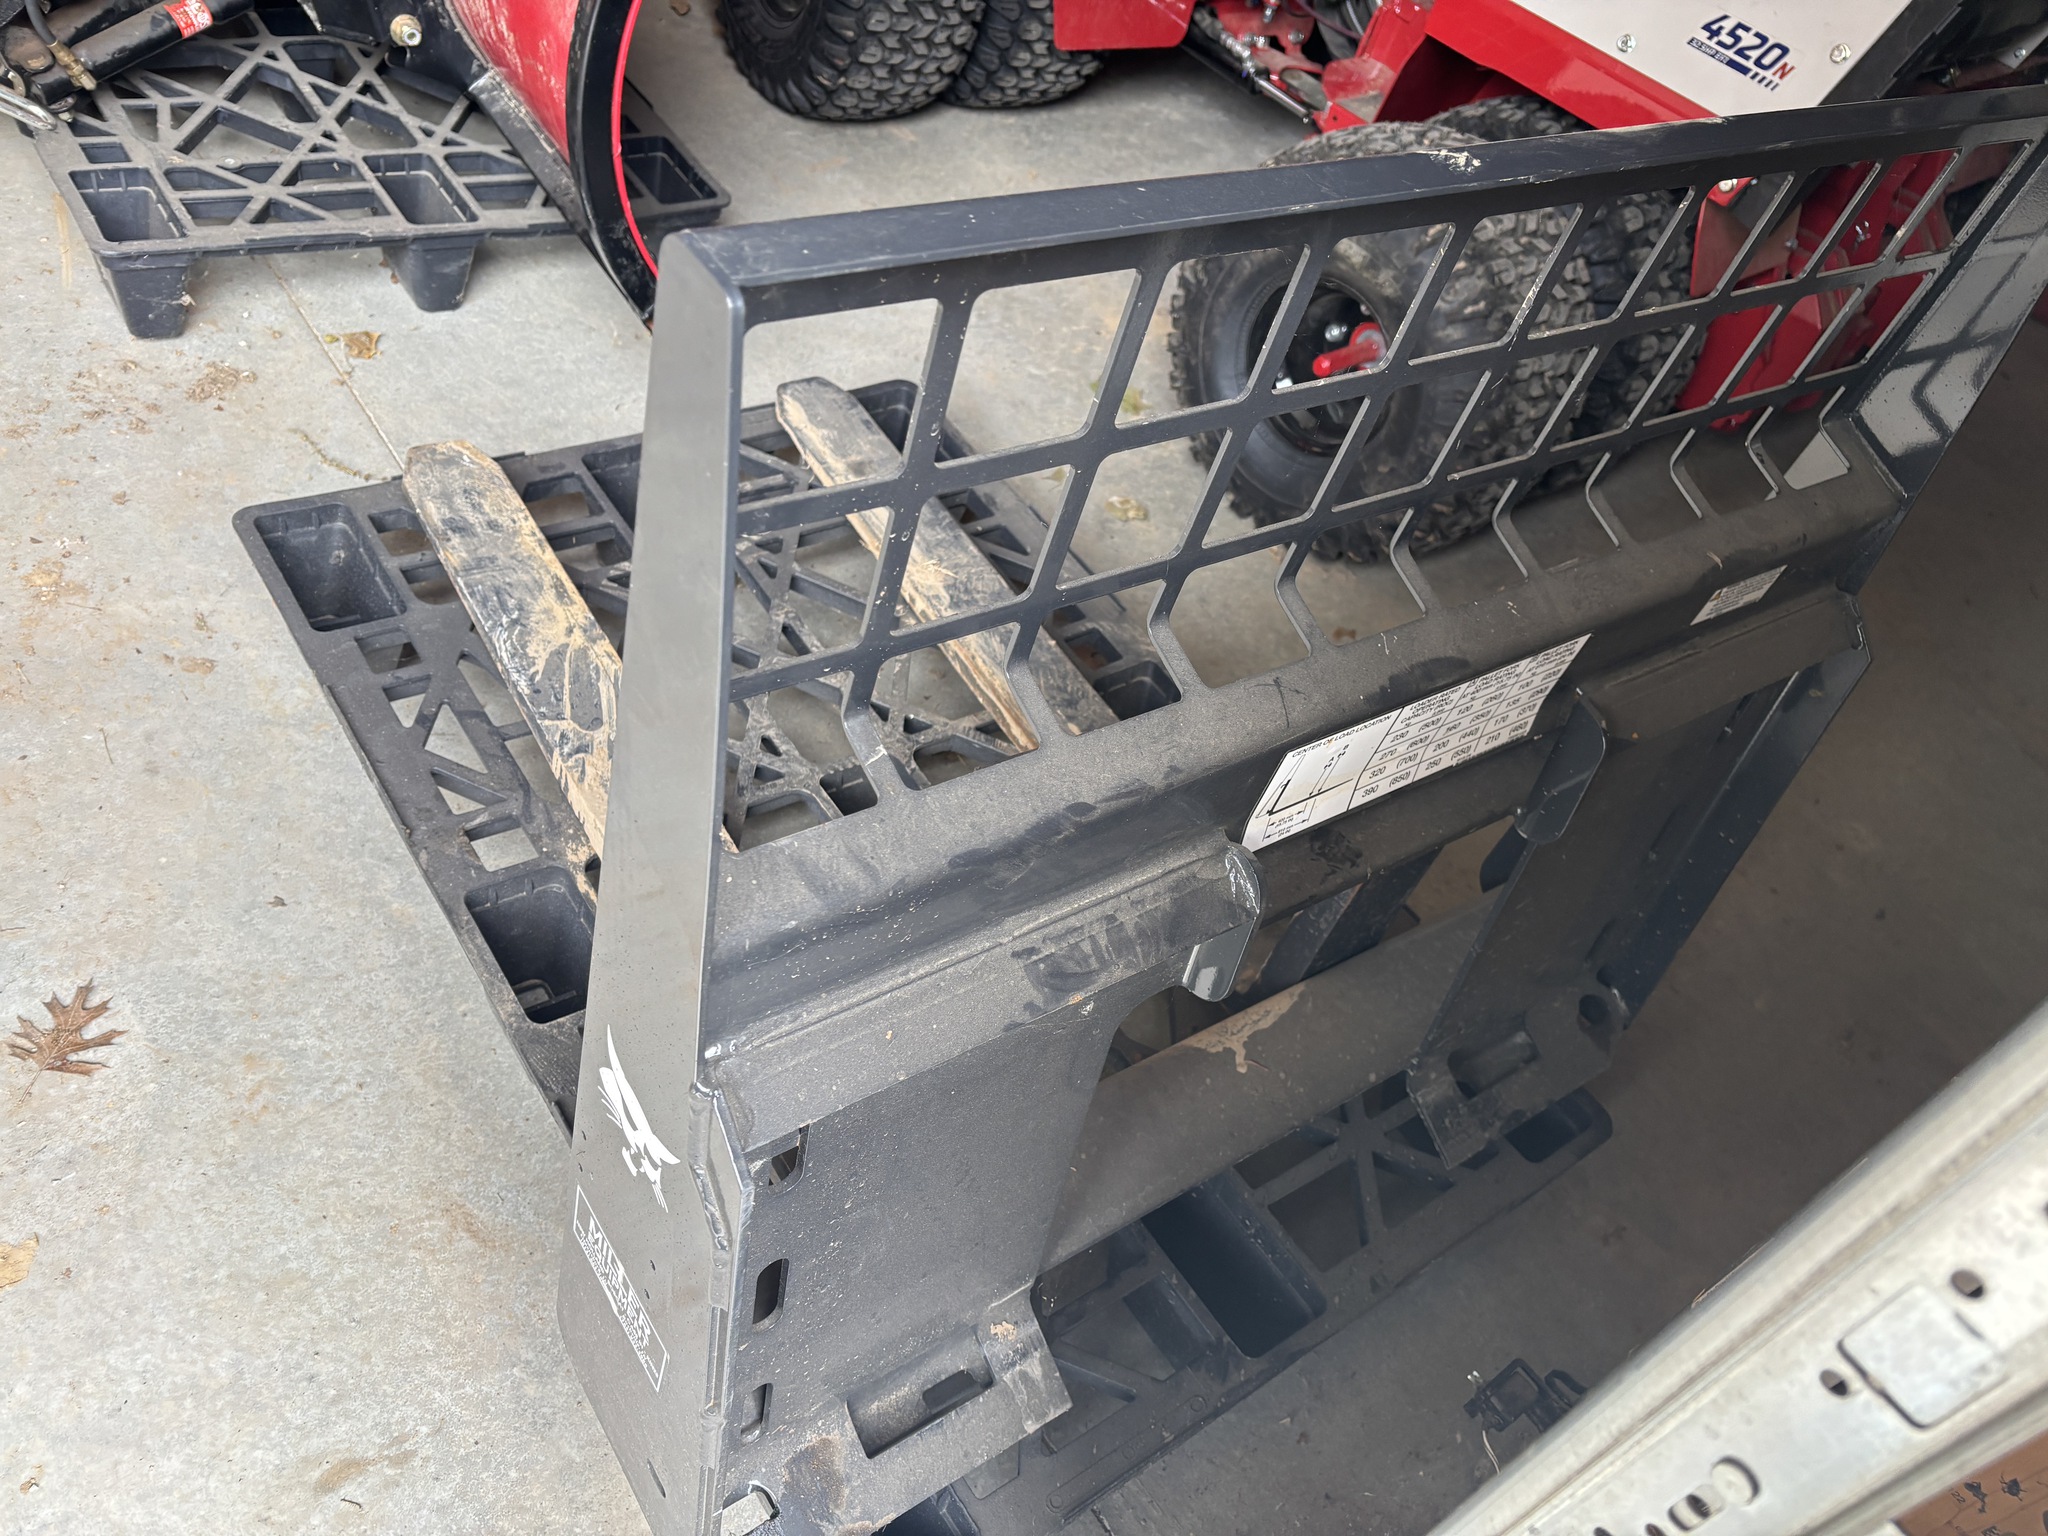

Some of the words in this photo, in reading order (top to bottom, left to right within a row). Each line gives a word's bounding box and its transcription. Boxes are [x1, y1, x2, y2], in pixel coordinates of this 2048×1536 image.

[1518, 680, 1534, 691] 100
[1410, 696, 1438, 710] LOADER
[1439, 687, 1461, 700] RATED
[1412, 696, 1451, 714] OPERATING
[1401, 708, 1432, 724] CAPACITY
[1457, 704, 1474, 716] 120
[1517, 702, 1537, 718] (370)
[1418, 717, 1442, 732] (500)
[1494, 714, 1509, 727] 170
[1292, 742, 1323, 758] CENTER
[1323, 737, 1334, 746] OF
[1334, 730, 1355, 741] LOAD
[1356, 714, 1392, 732] LOCATION
[1390, 730, 1409, 743] 230
[1458, 726, 1480, 742] (440)
[1485, 732, 1501, 745] 210
[1433, 740, 1450, 752] 200
[1451, 744, 1472, 761] (550)
[1379, 748, 1397, 760] 270
[1396, 752, 1418, 769] (700)
[1425, 758, 1442, 771] 250
[1369, 766, 1386, 779] 320
[1389, 771, 1410, 788] (850)
[1362, 784, 1379, 798] 390
[588, 1215, 651, 1343] MILLER
[587, 1231, 650, 1347] EQUIPMENT
